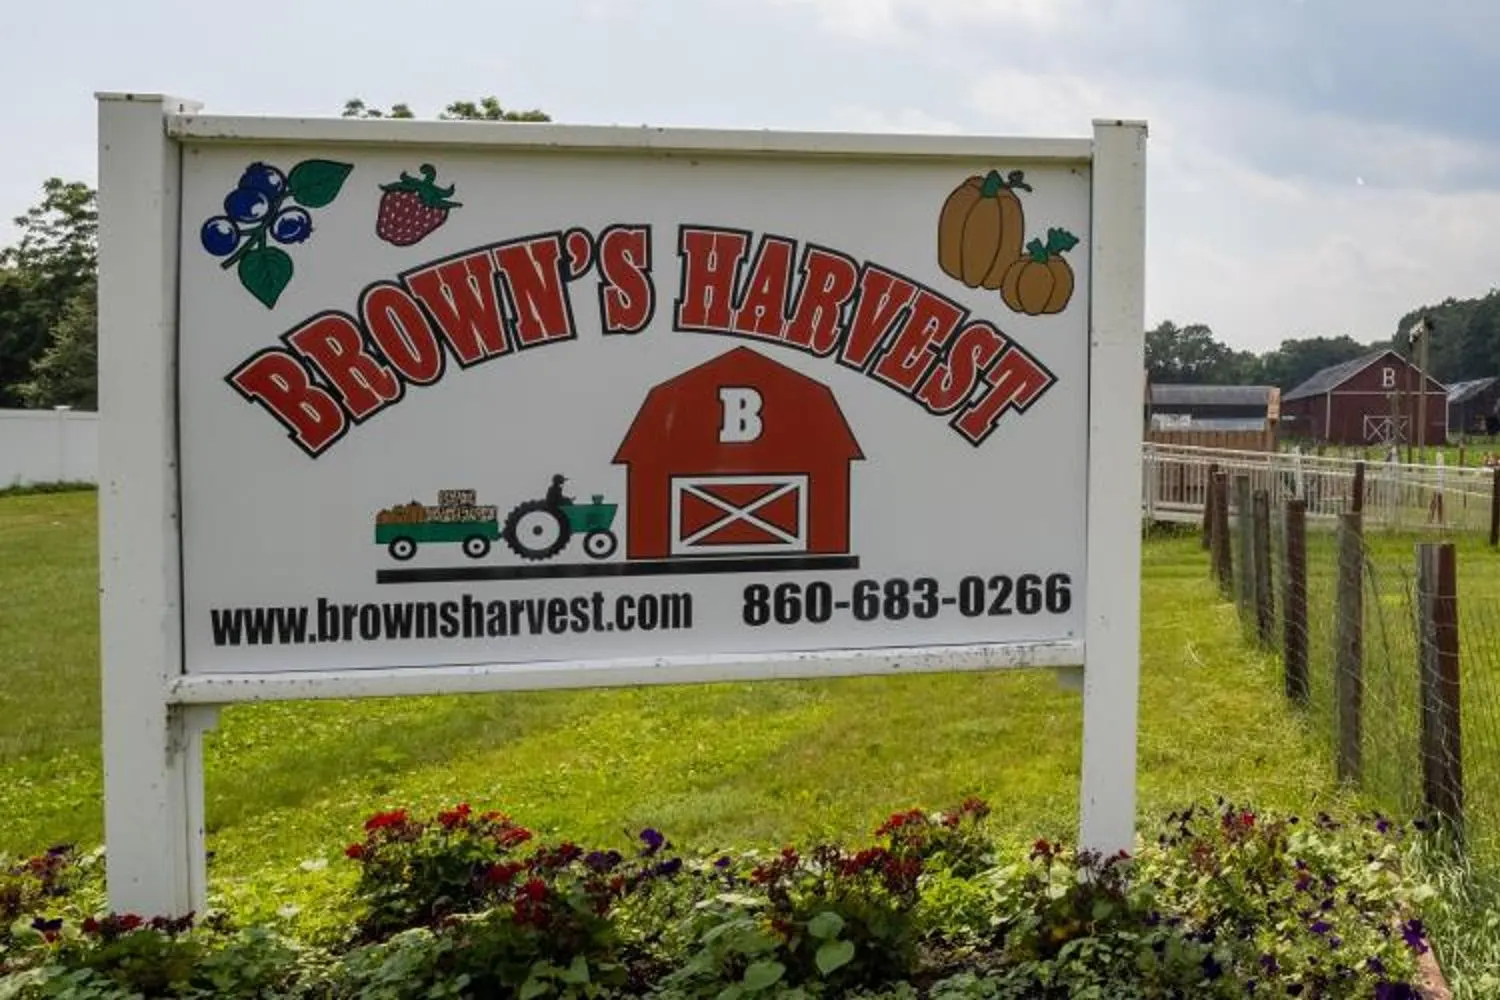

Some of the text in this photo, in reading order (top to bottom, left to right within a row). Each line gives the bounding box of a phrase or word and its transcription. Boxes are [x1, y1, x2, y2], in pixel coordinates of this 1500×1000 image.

[224, 224, 1058, 459] BROWN'S HARVEST
[1383, 367, 1395, 388] B
[718, 386, 763, 443] B
[211, 573, 1072, 646] www.brownsharvest.com 860-683-0266
